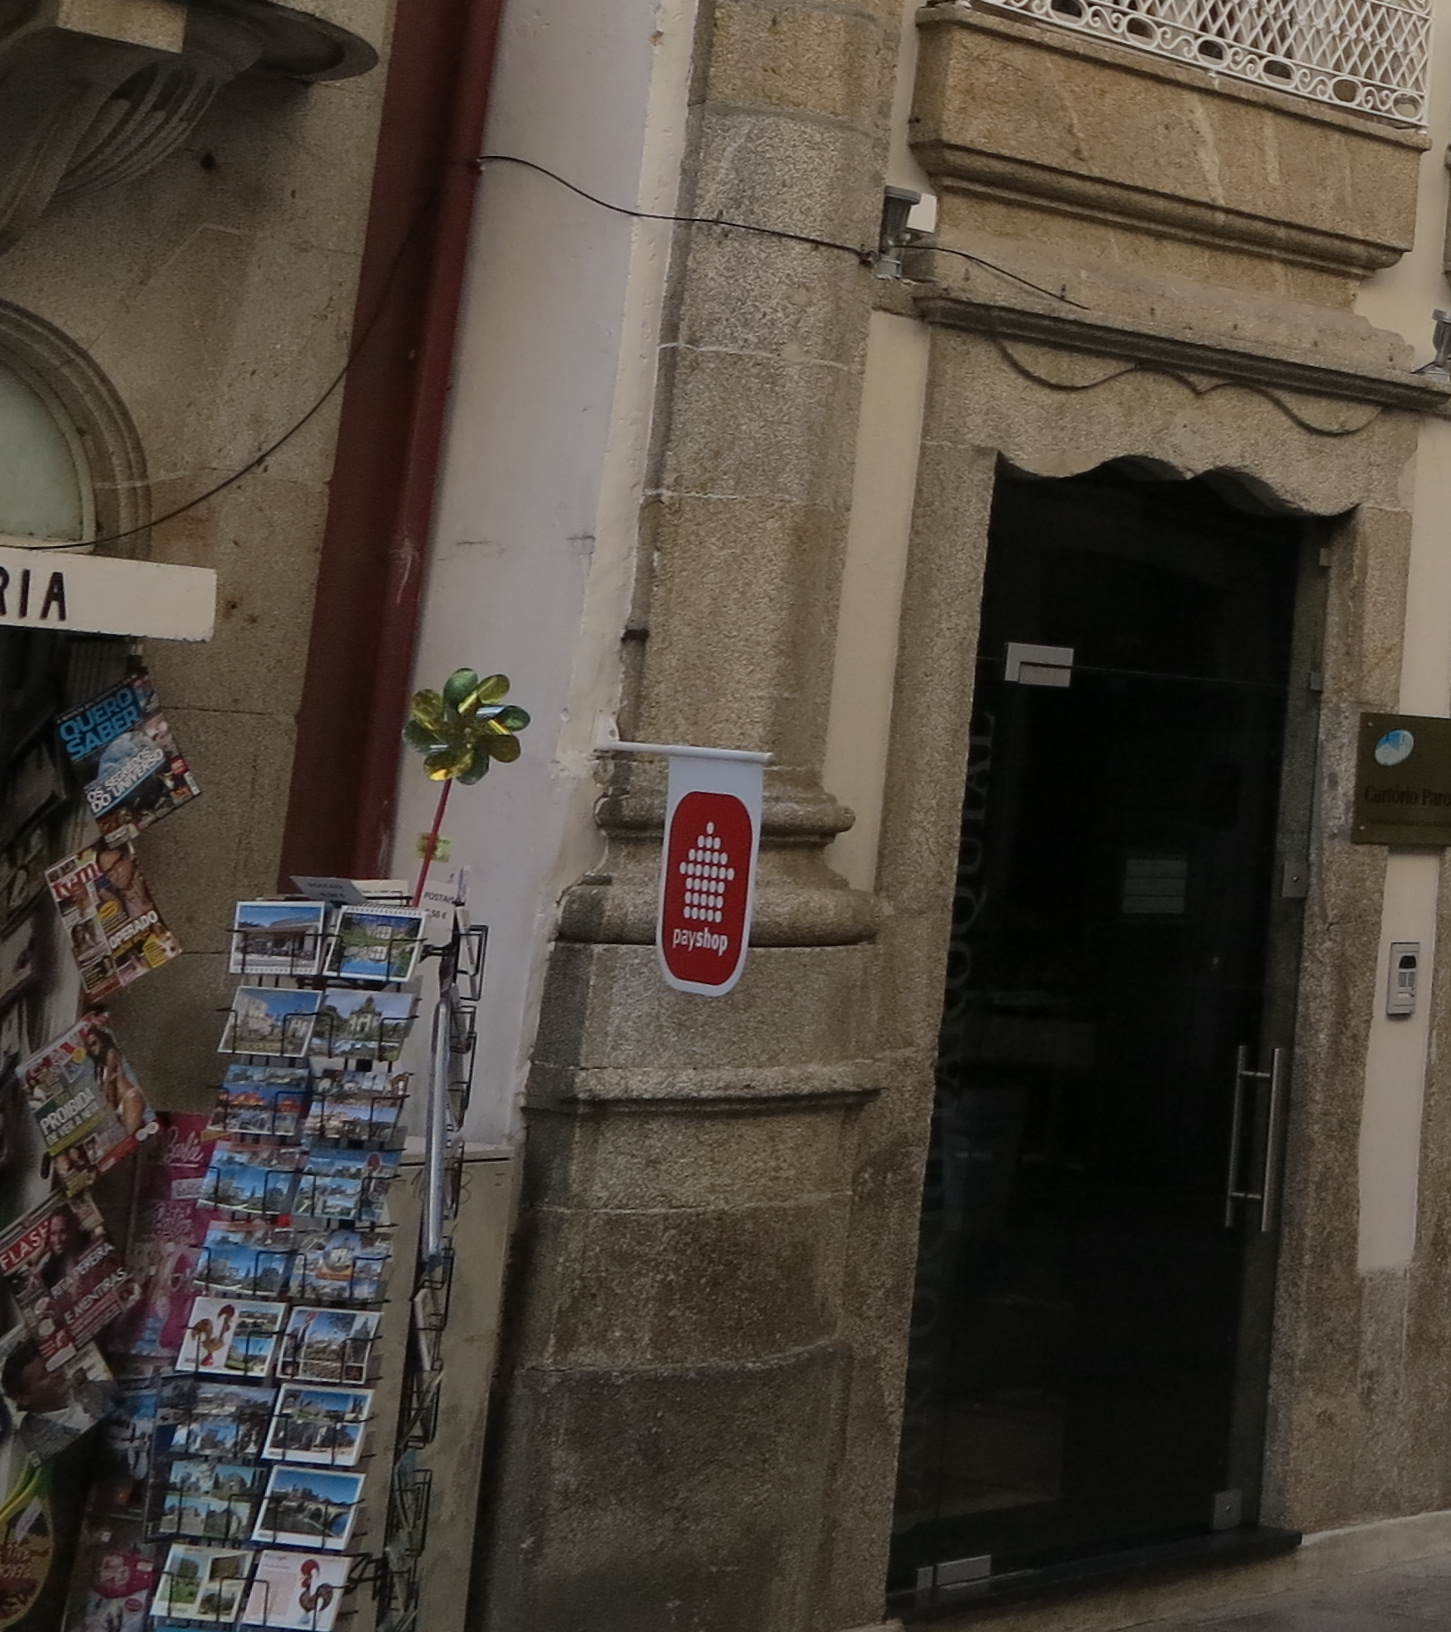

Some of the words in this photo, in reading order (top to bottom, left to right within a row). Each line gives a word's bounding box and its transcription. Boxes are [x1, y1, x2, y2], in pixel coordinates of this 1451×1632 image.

[59, 688, 135, 743] QUERO
[65, 708, 140, 762] SABER
[423, 890, 455, 905] POSTAI
[672, 926, 729, 957] payshop
